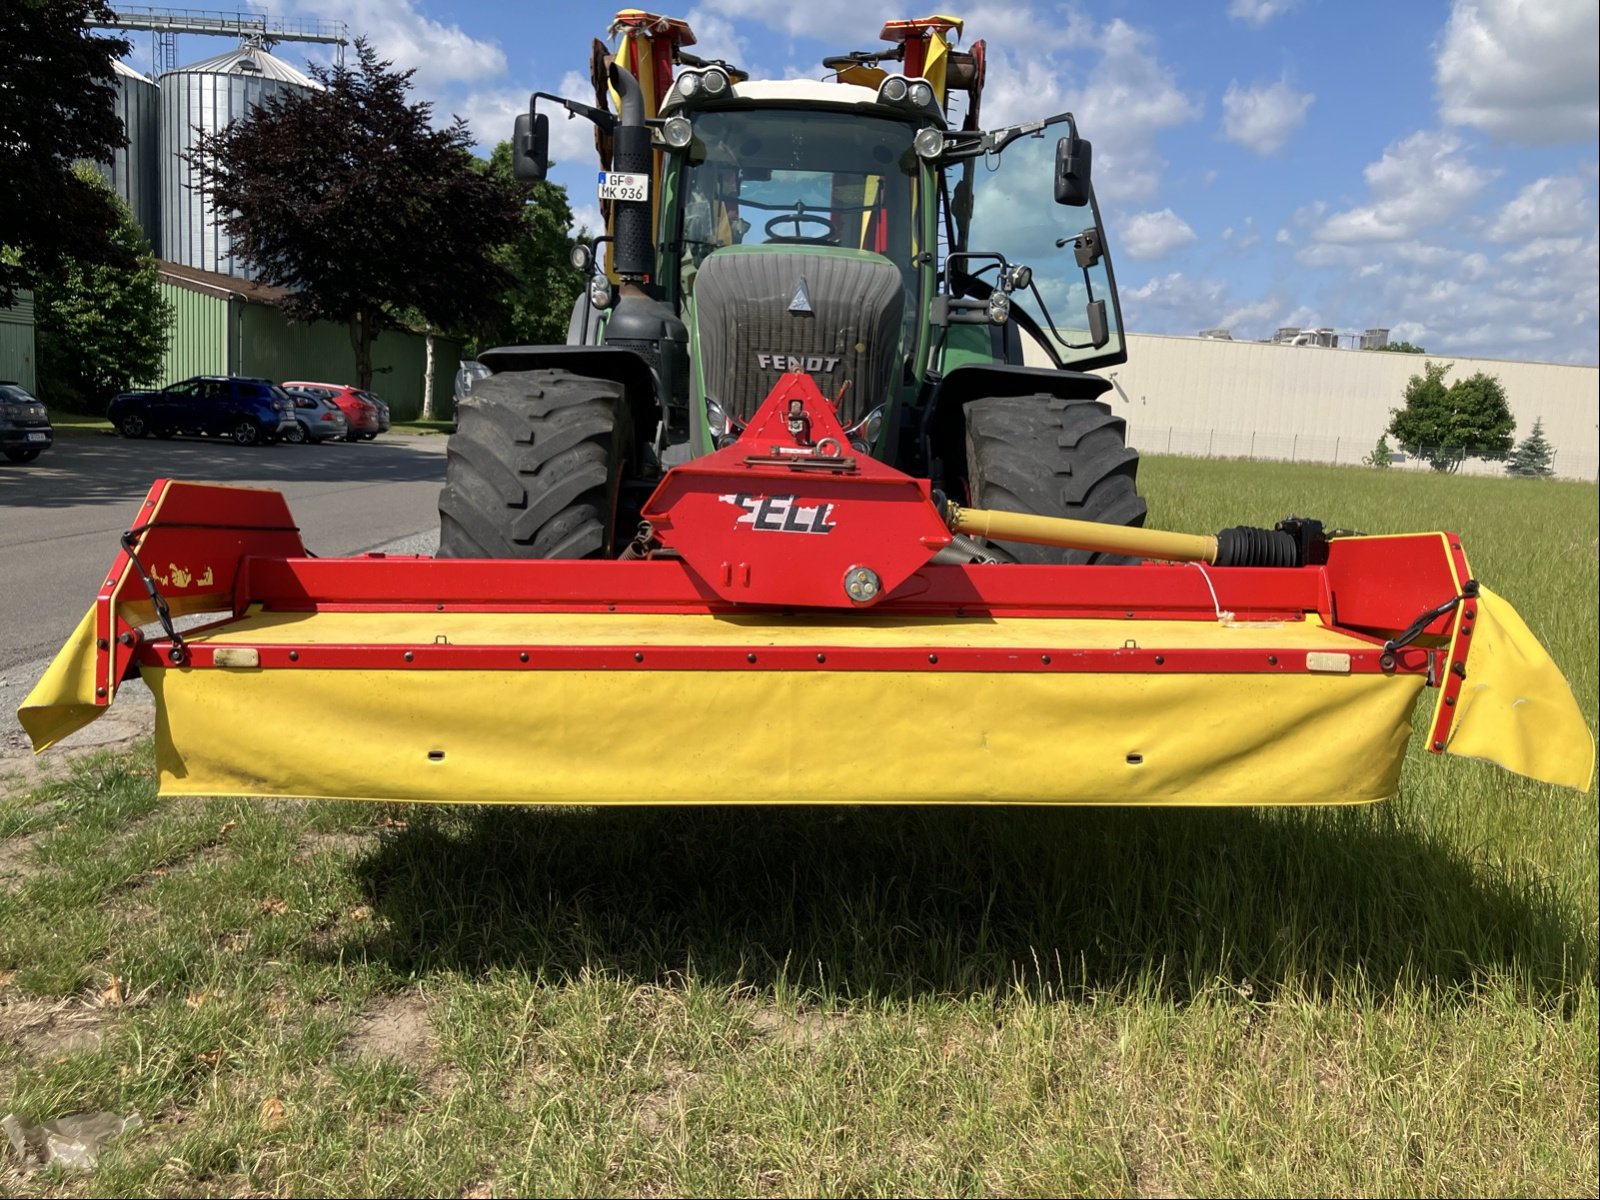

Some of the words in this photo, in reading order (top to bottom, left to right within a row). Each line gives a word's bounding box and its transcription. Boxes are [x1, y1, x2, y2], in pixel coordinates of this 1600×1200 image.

[609, 174, 625, 186] GF
[601, 187, 617, 199] MK
[620, 187, 643, 200] 936
[757, 354, 839, 373] FENDT
